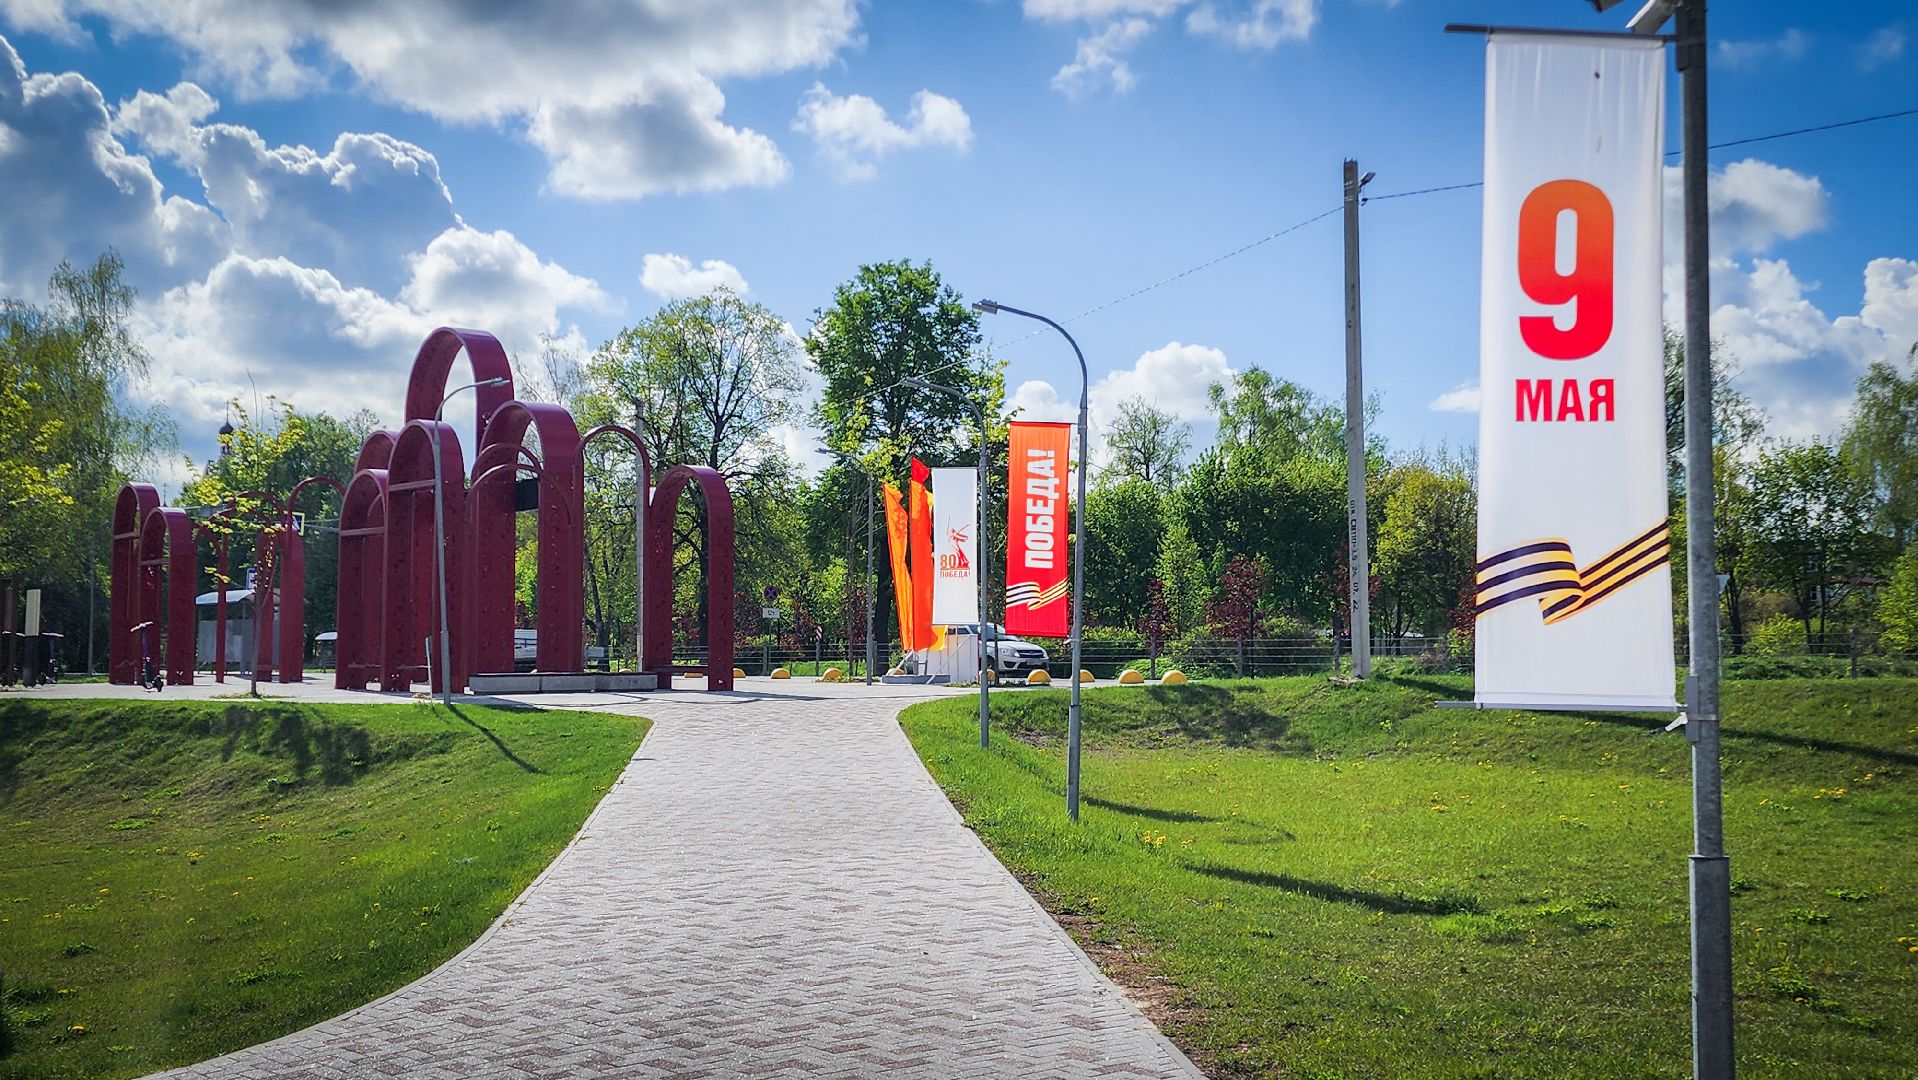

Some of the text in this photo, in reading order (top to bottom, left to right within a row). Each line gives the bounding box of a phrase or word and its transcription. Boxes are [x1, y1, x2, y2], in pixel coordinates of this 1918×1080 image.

[1518, 179, 1614, 361] 9
[1515, 379, 1615, 422] МАЯ
[1025, 449, 1060, 569] ПОБЕДА!
[940, 554, 956, 568] 80
